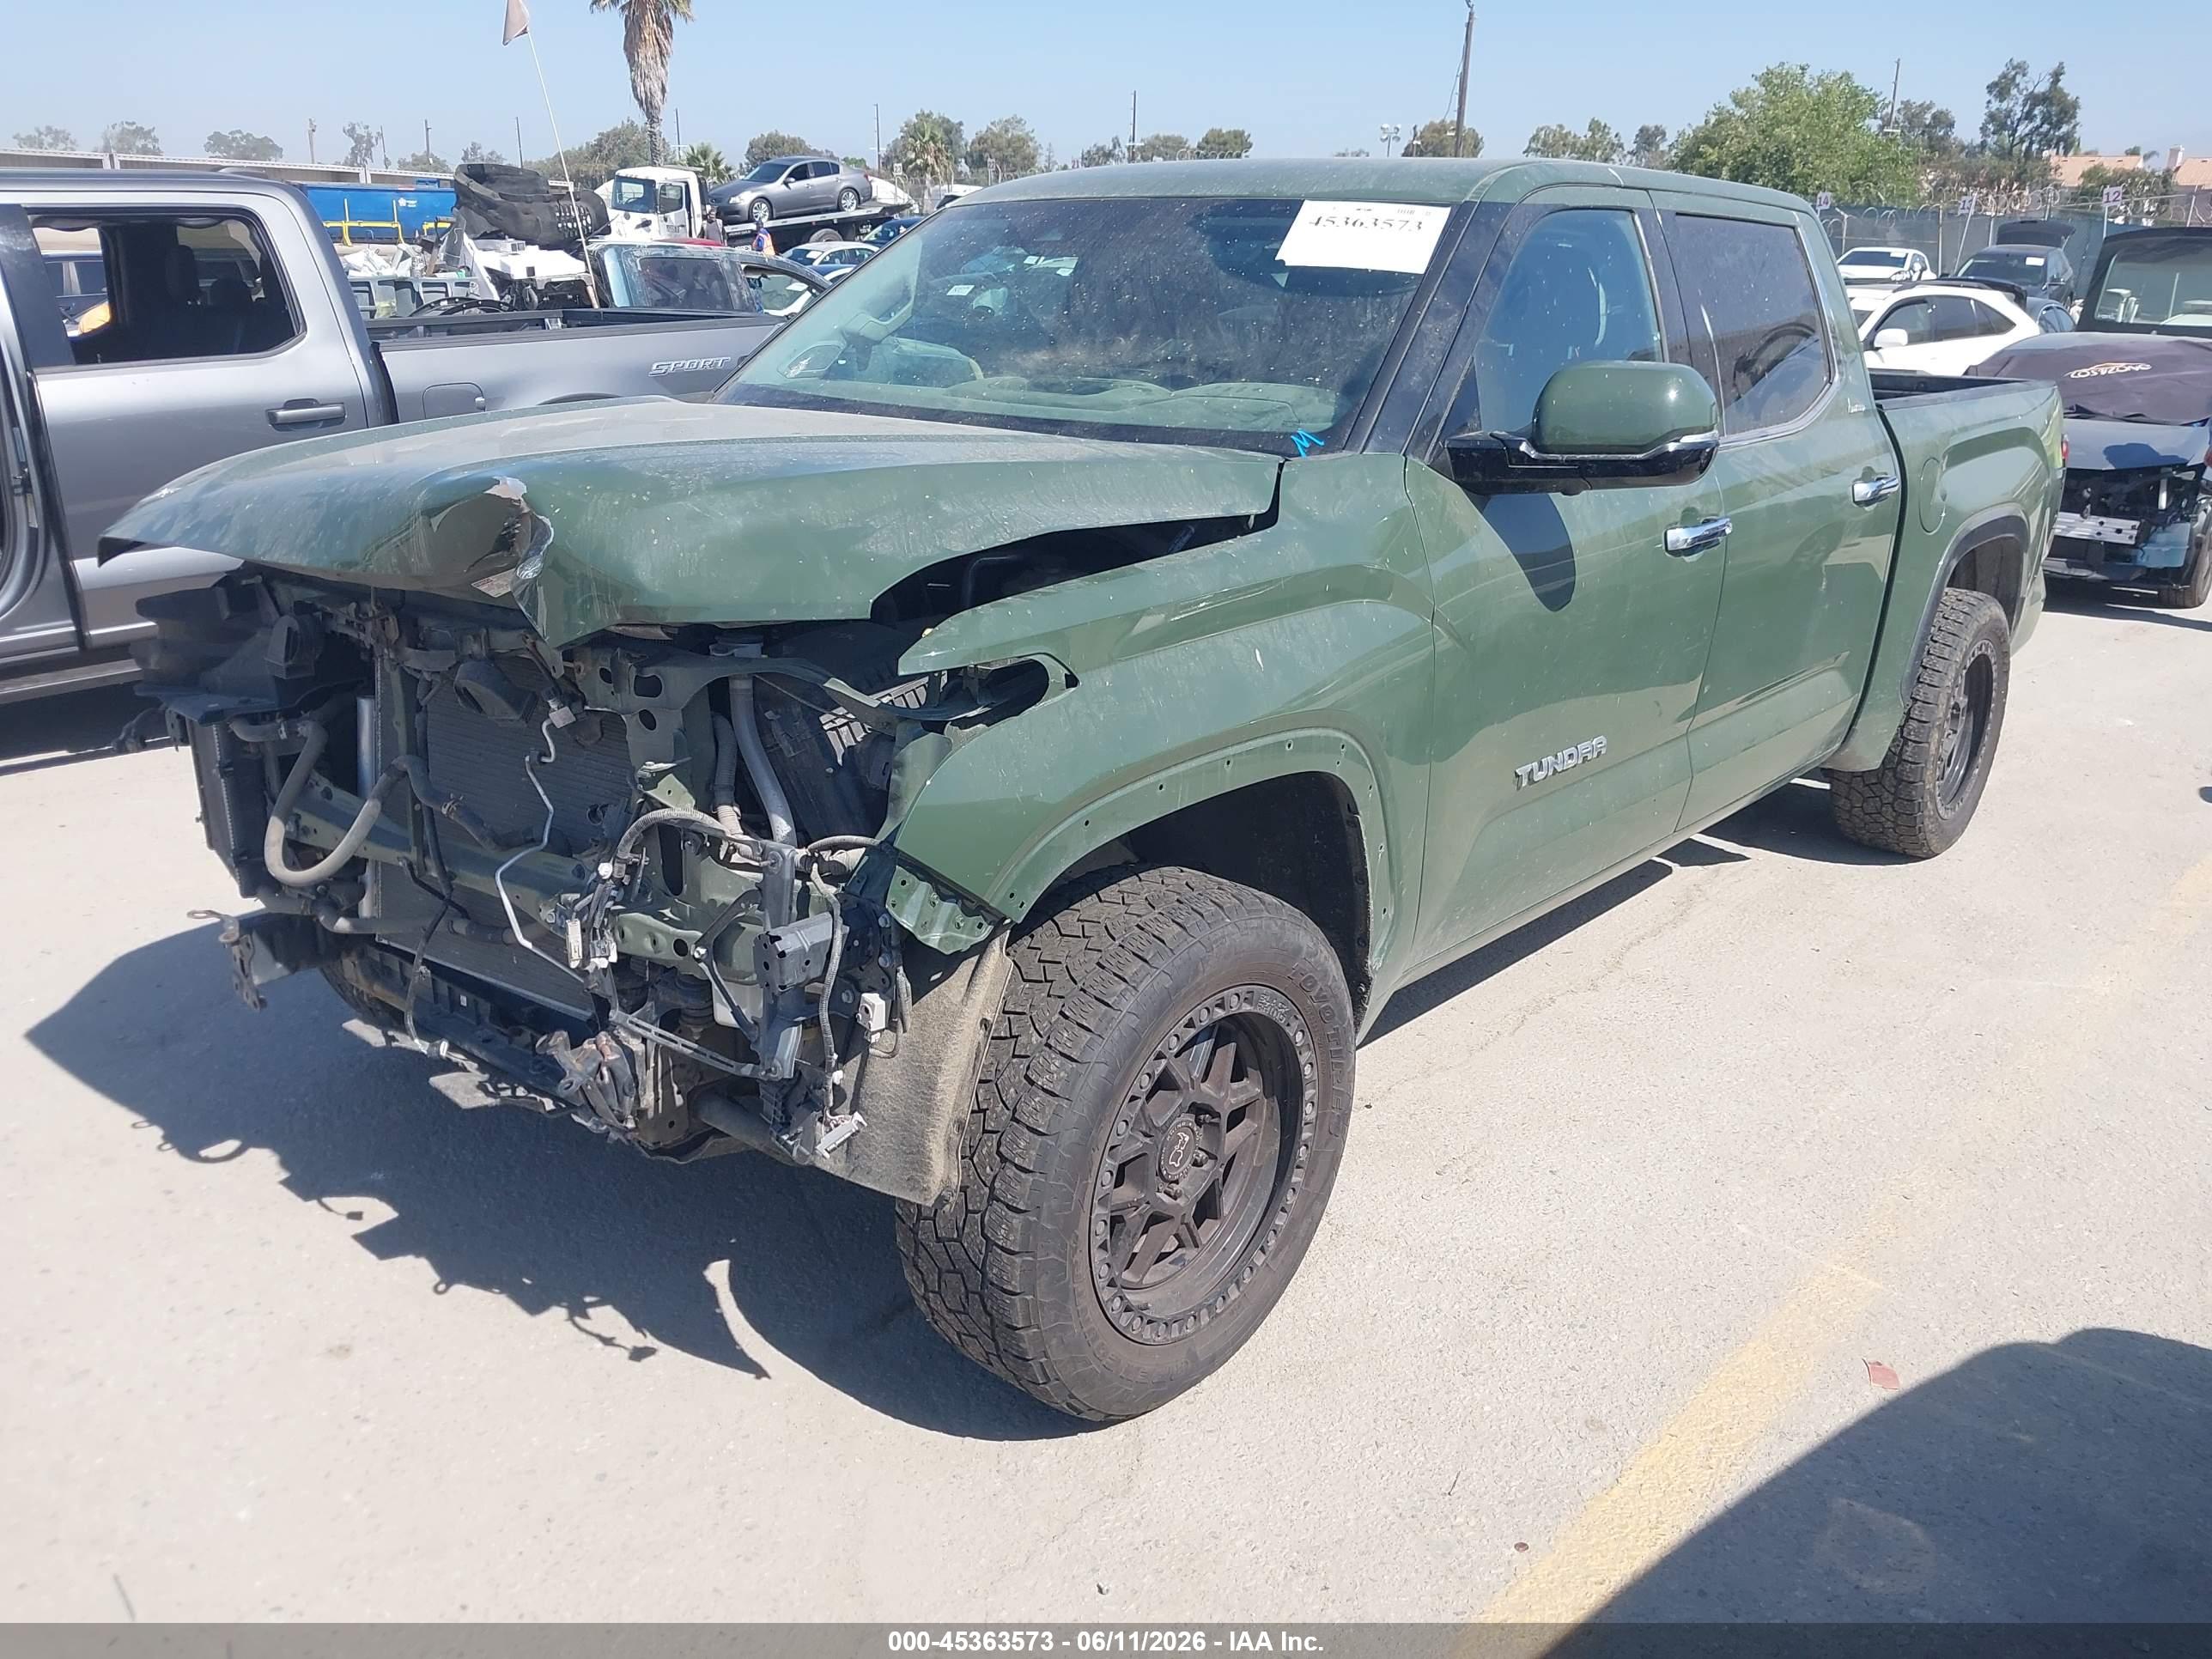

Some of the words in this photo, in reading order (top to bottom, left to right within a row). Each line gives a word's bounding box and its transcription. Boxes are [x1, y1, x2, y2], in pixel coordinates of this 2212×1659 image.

[1818, 196, 1830, 206] 14
[2104, 191, 2121, 204] 12
[1309, 216, 1423, 232] 45363573
[648, 357, 731, 376] SPORT
[1514, 735, 1607, 790] TUNDRA
